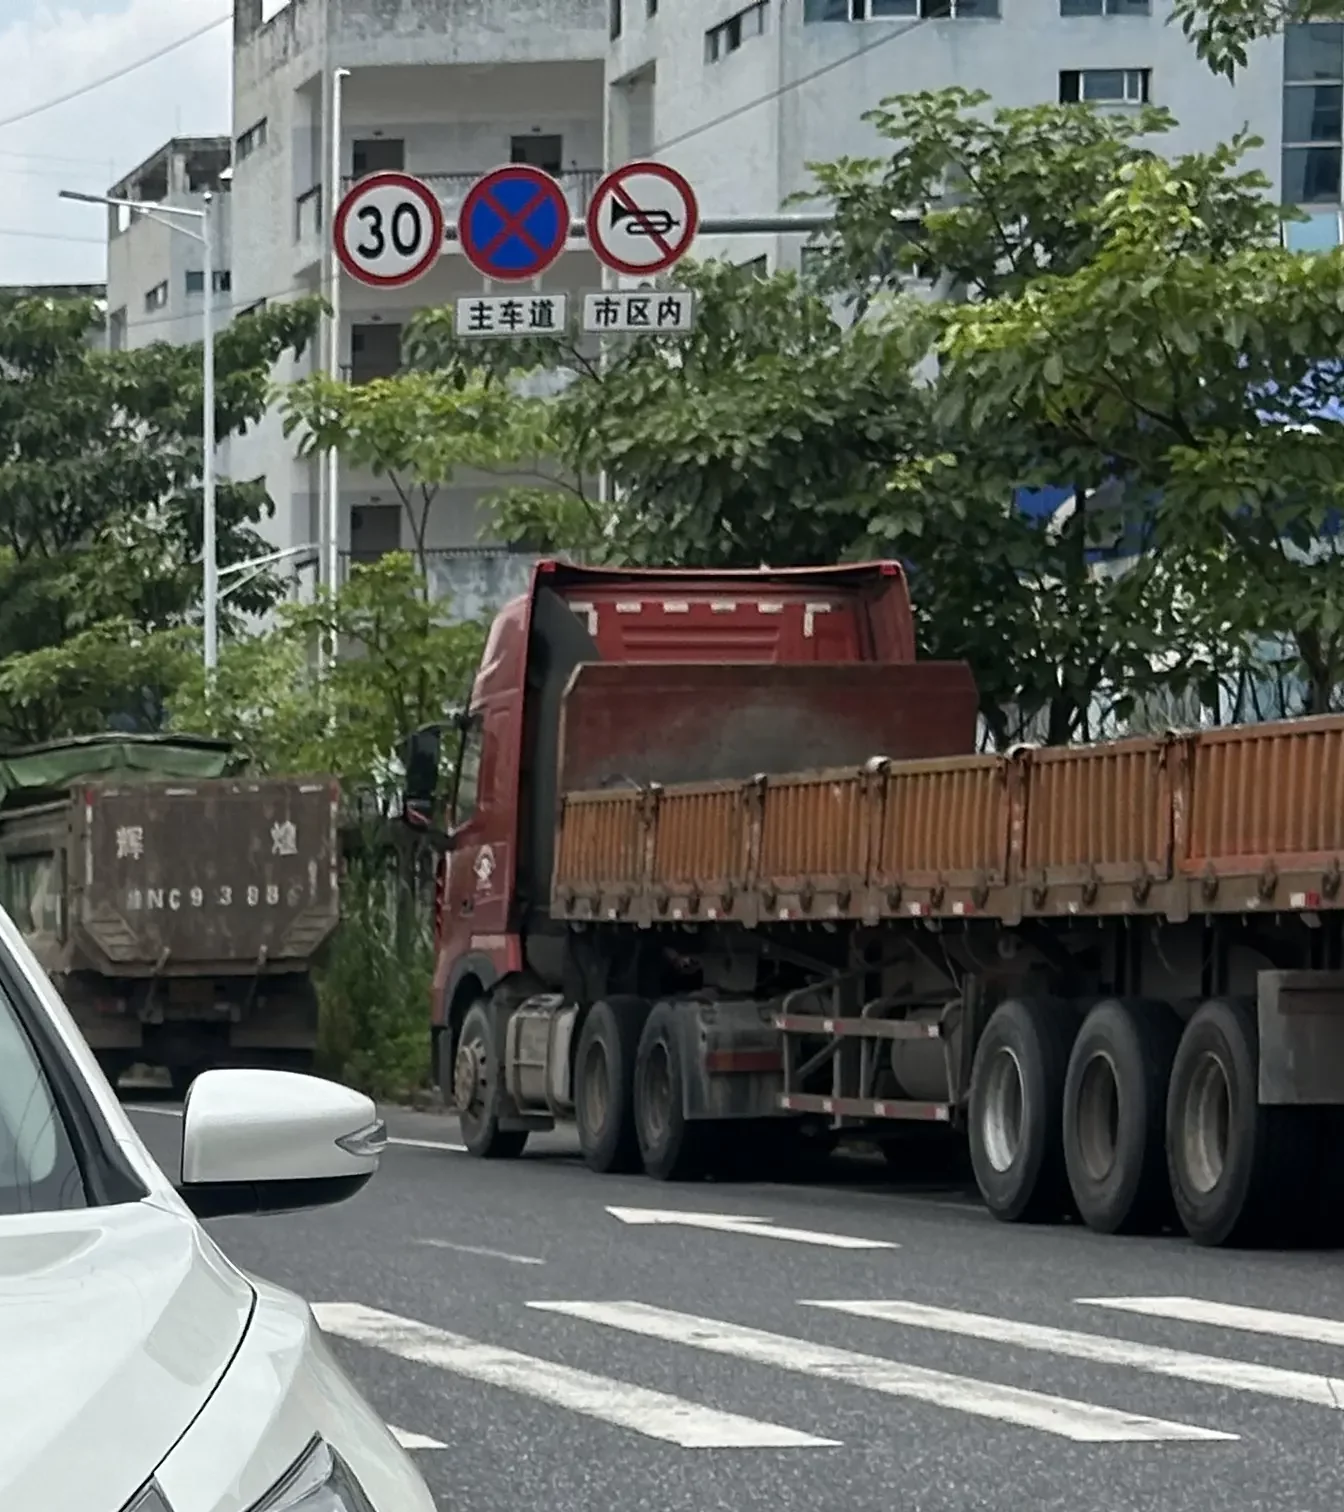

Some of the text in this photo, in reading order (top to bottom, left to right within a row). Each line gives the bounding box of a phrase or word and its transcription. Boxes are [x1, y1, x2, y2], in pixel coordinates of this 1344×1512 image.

[357, 202, 421, 260] 30
[468, 300, 555, 330] 主车道
[594, 296, 682, 328] 市区内
